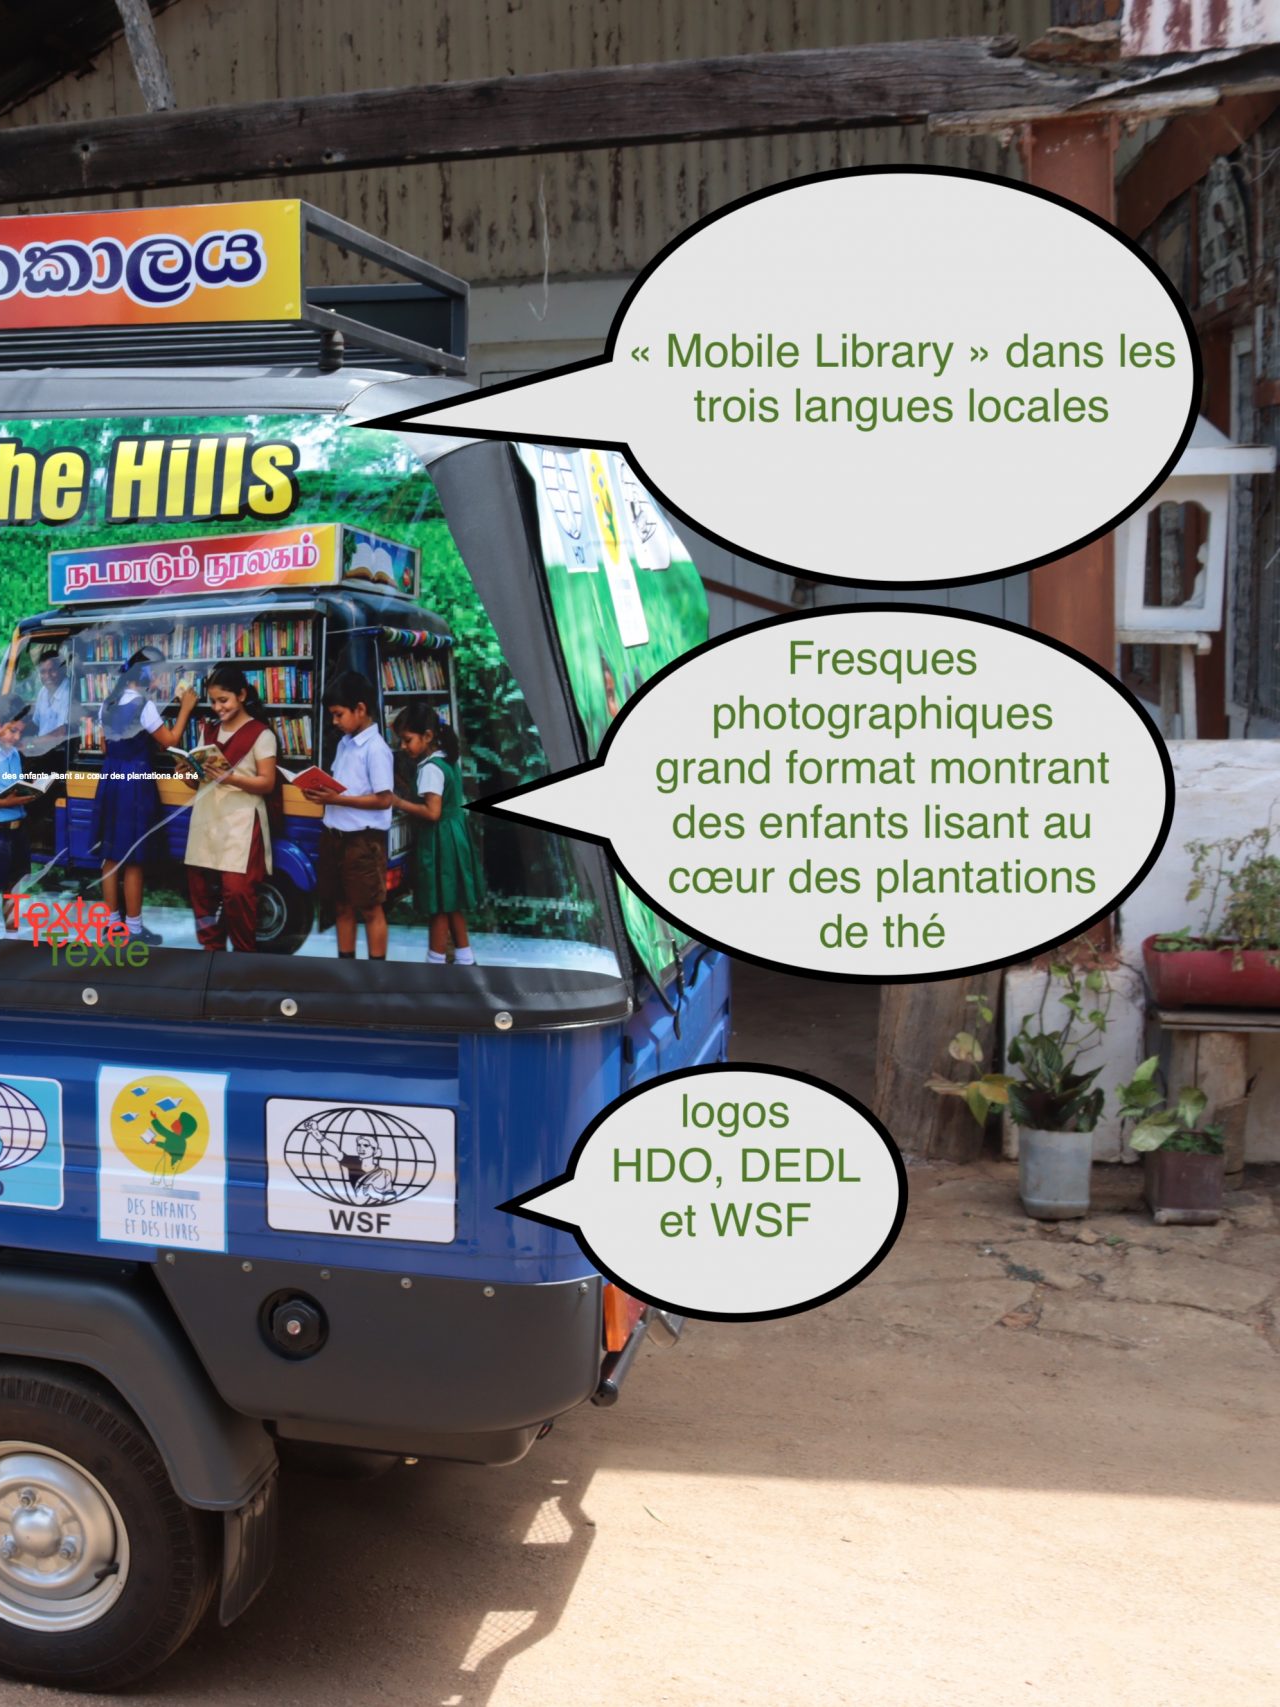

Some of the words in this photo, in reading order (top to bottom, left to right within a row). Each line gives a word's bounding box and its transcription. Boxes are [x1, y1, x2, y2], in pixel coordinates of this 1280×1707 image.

[110, 435, 301, 521] Hills
[64, 545, 199, 594] நடமாடும்
[205, 533, 319, 586] நூலகம்
[127, 1197, 146, 1216] DES
[151, 1199, 197, 1221] ENFANTS
[328, 1208, 392, 1236] WSF
[125, 1218, 136, 1234] ET
[141, 1220, 160, 1238] DES
[164, 1222, 200, 1242] LIVRES
